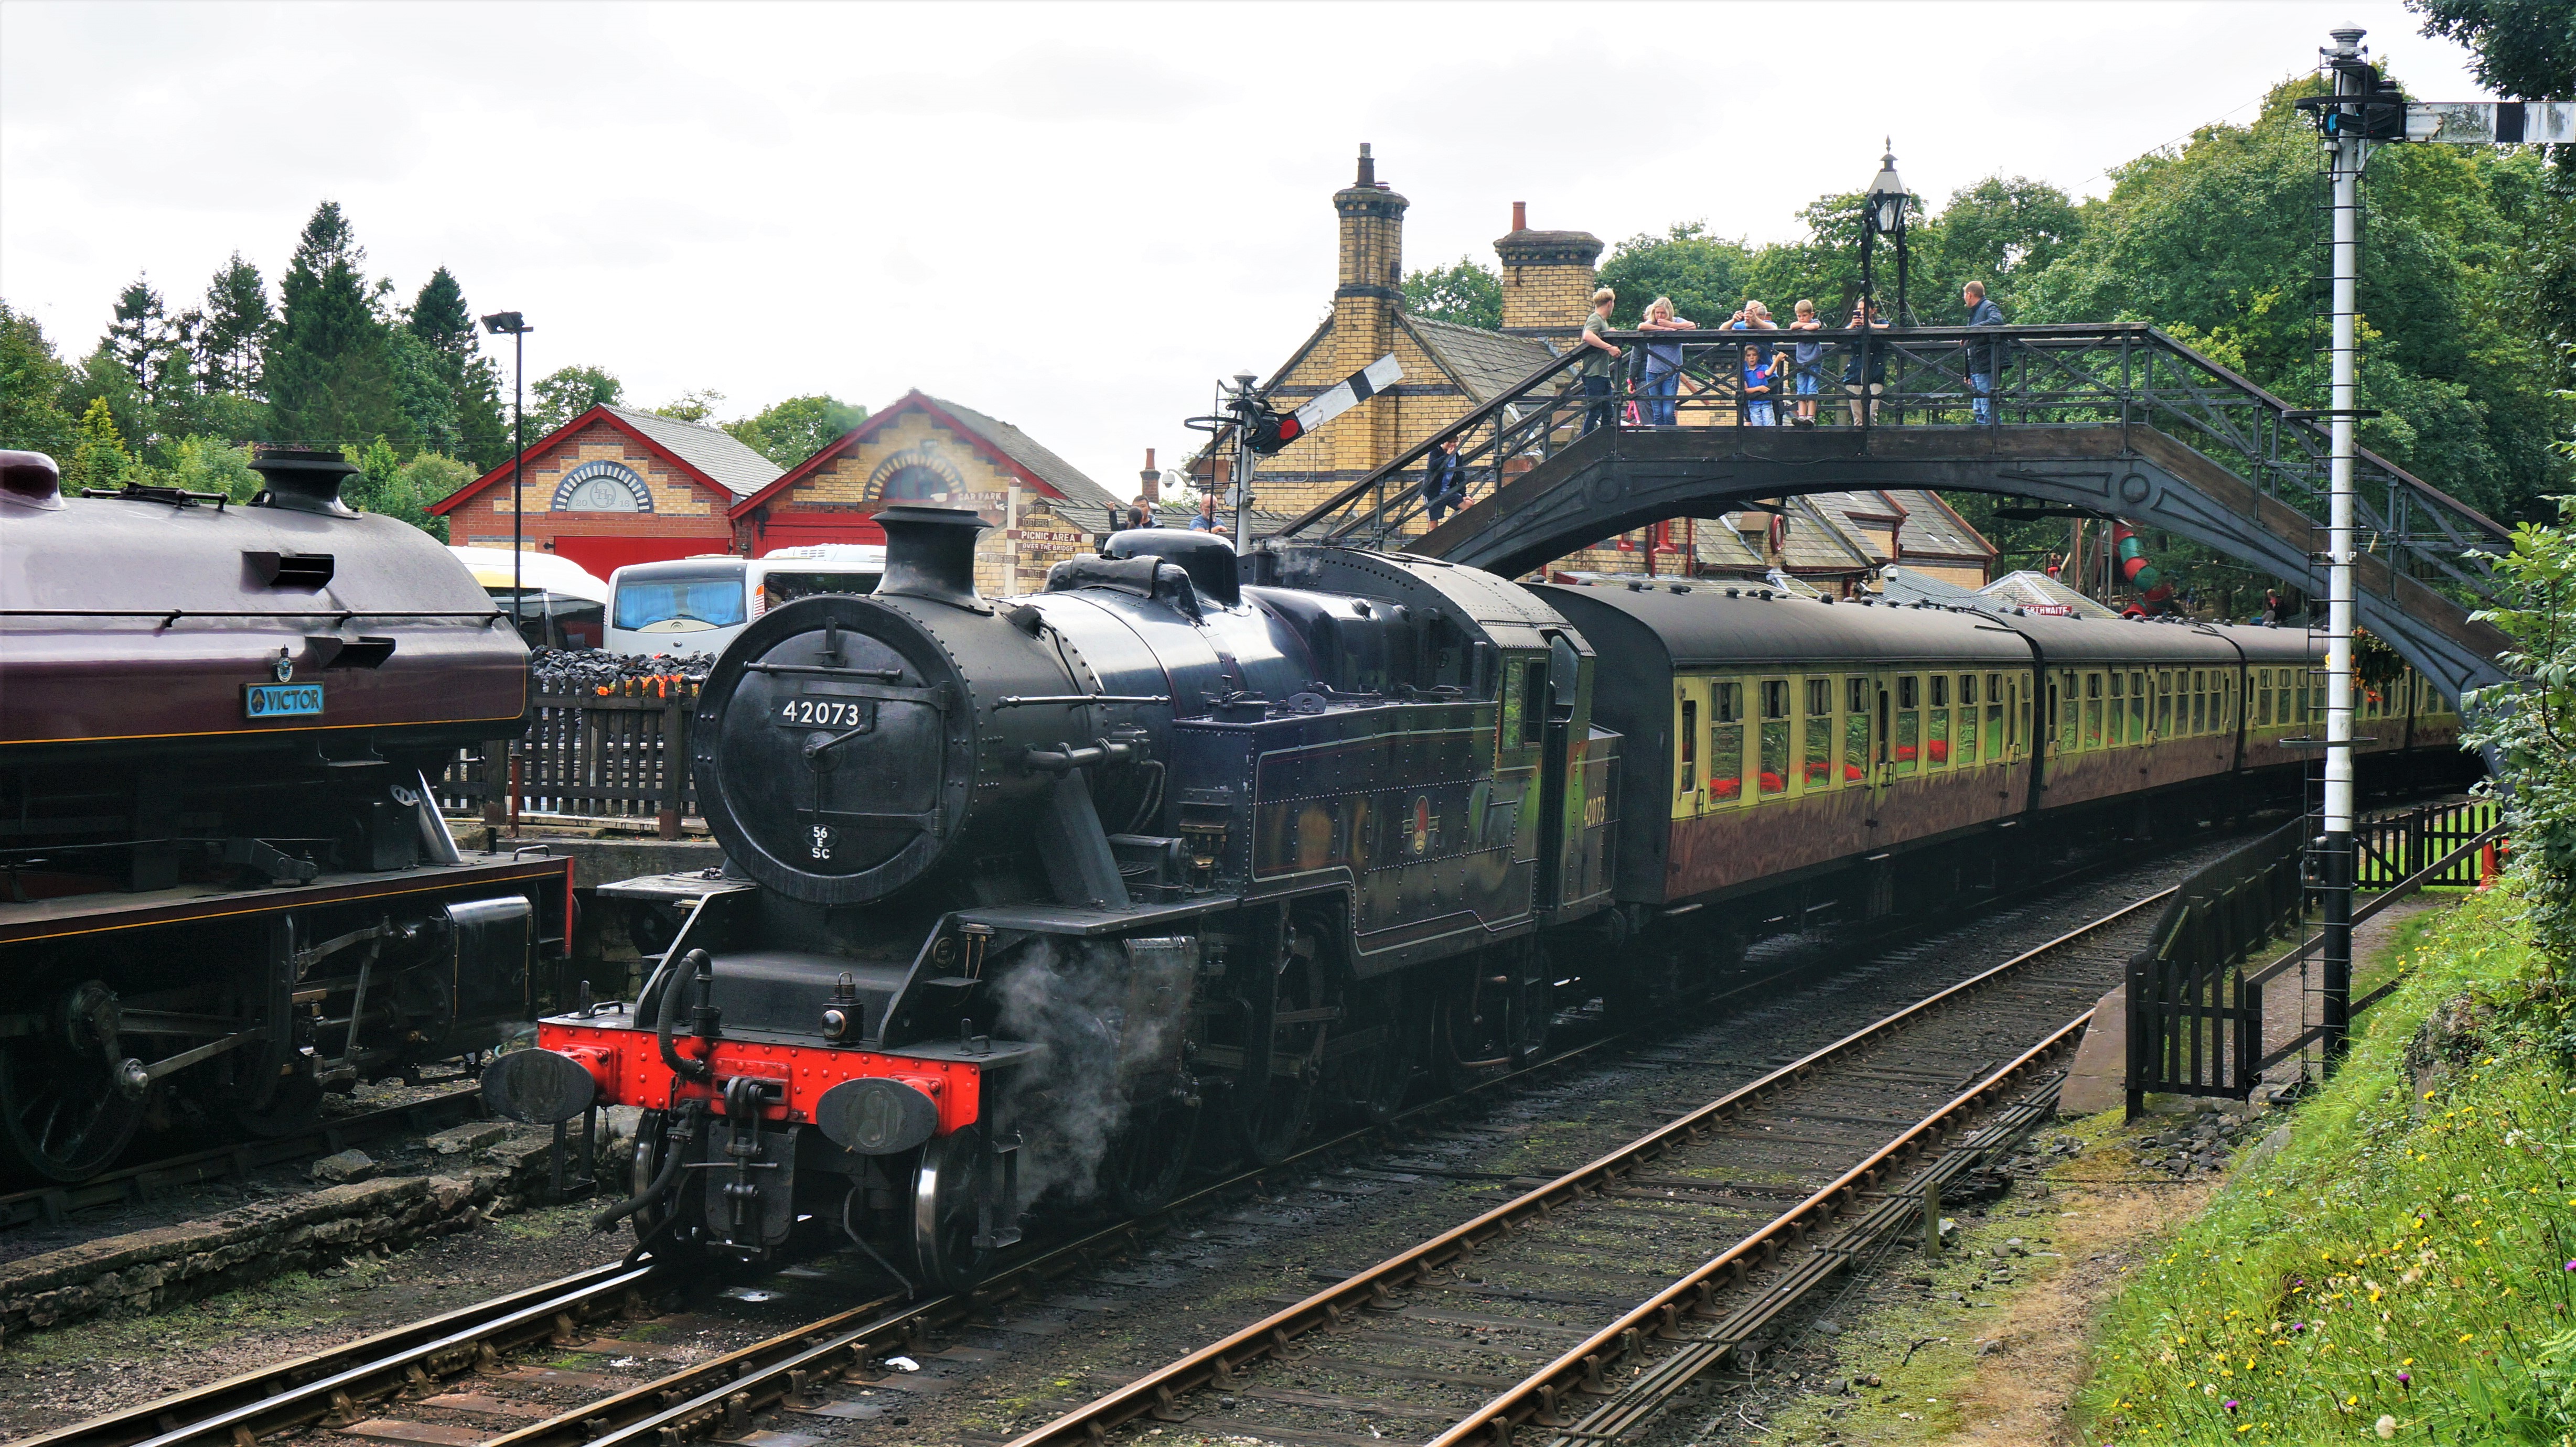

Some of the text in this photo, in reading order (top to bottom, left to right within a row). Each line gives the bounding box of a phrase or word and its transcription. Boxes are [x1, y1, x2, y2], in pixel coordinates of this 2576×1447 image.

[978, 492, 1002, 501] PARK
[1021, 531, 1075, 542] PICNIC AREA
[1027, 569, 1040, 578] TOILET
[266, 688, 319, 711] VICTOR
[782, 700, 858, 726] 42073
[1583, 795, 1605, 828] 42073
[813, 826, 828, 839] 56
[817, 837, 823, 847] E
[812, 847, 830, 859] SC
